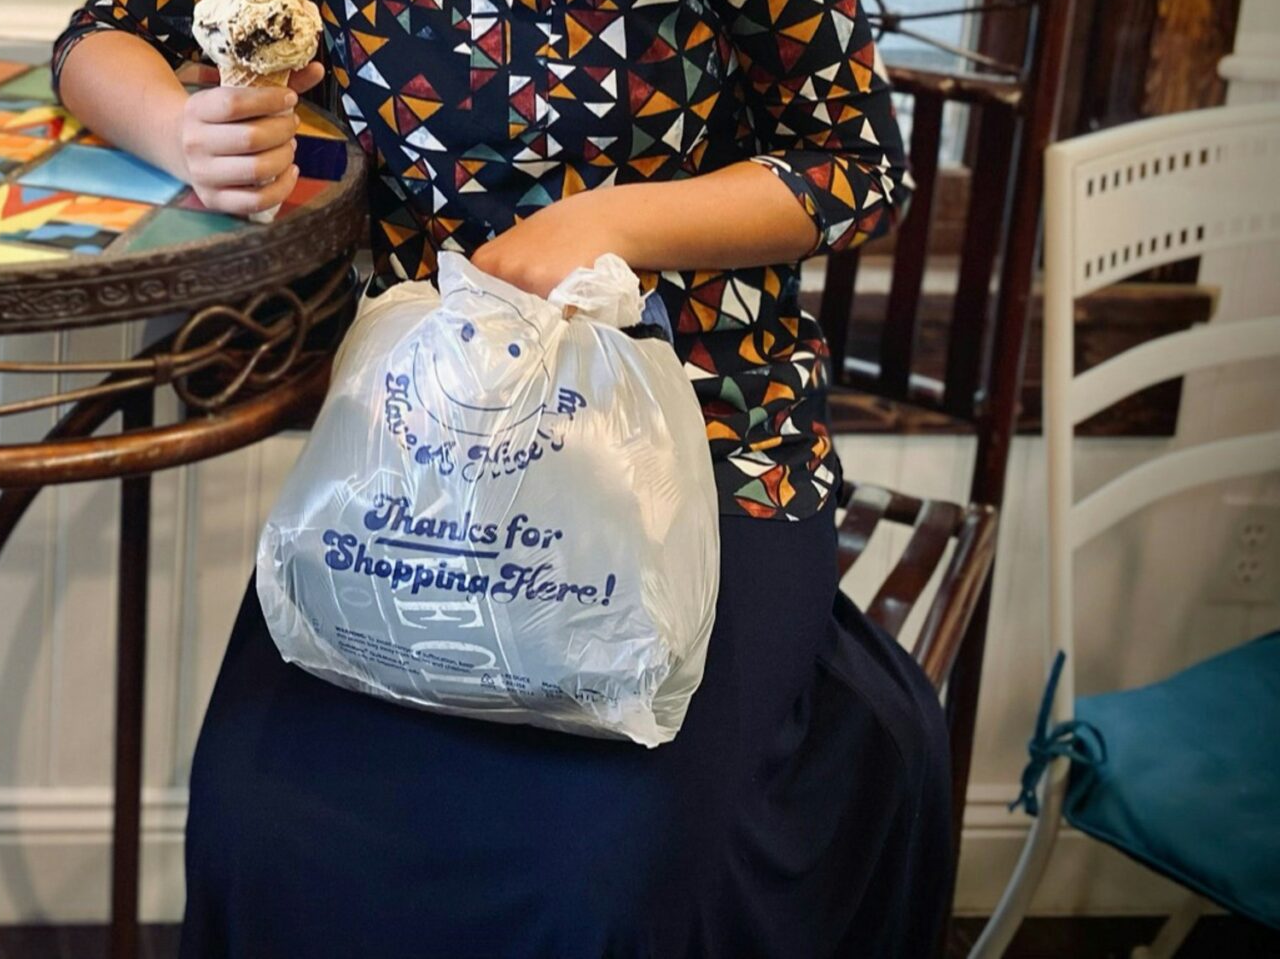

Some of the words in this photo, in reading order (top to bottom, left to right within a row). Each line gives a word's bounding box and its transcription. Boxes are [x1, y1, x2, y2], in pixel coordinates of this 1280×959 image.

[363, 493, 499, 544] Thanks
[504, 513, 563, 550] for
[322, 528, 490, 602] Shopping
[490, 562, 617, 607] Here!
